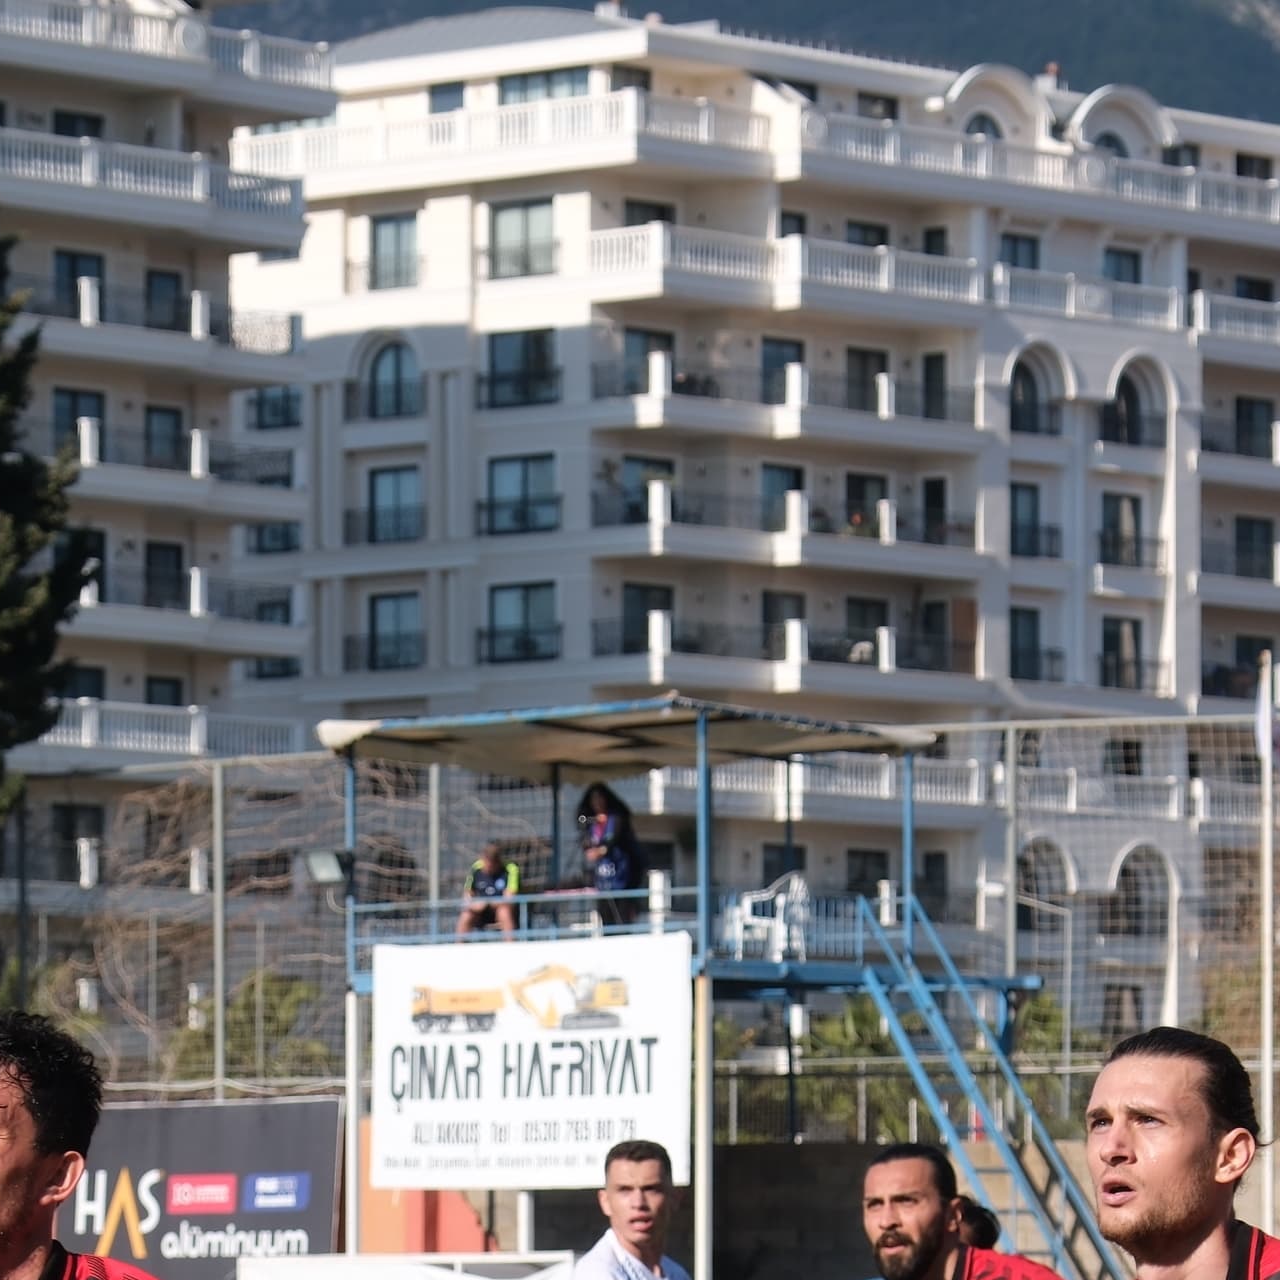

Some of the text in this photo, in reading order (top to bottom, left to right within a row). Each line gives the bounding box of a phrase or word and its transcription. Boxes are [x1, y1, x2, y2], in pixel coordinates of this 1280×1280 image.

[390, 1037, 659, 1112] ÇINAR HAFRİYAT
[74, 1166, 162, 1260] HAS
